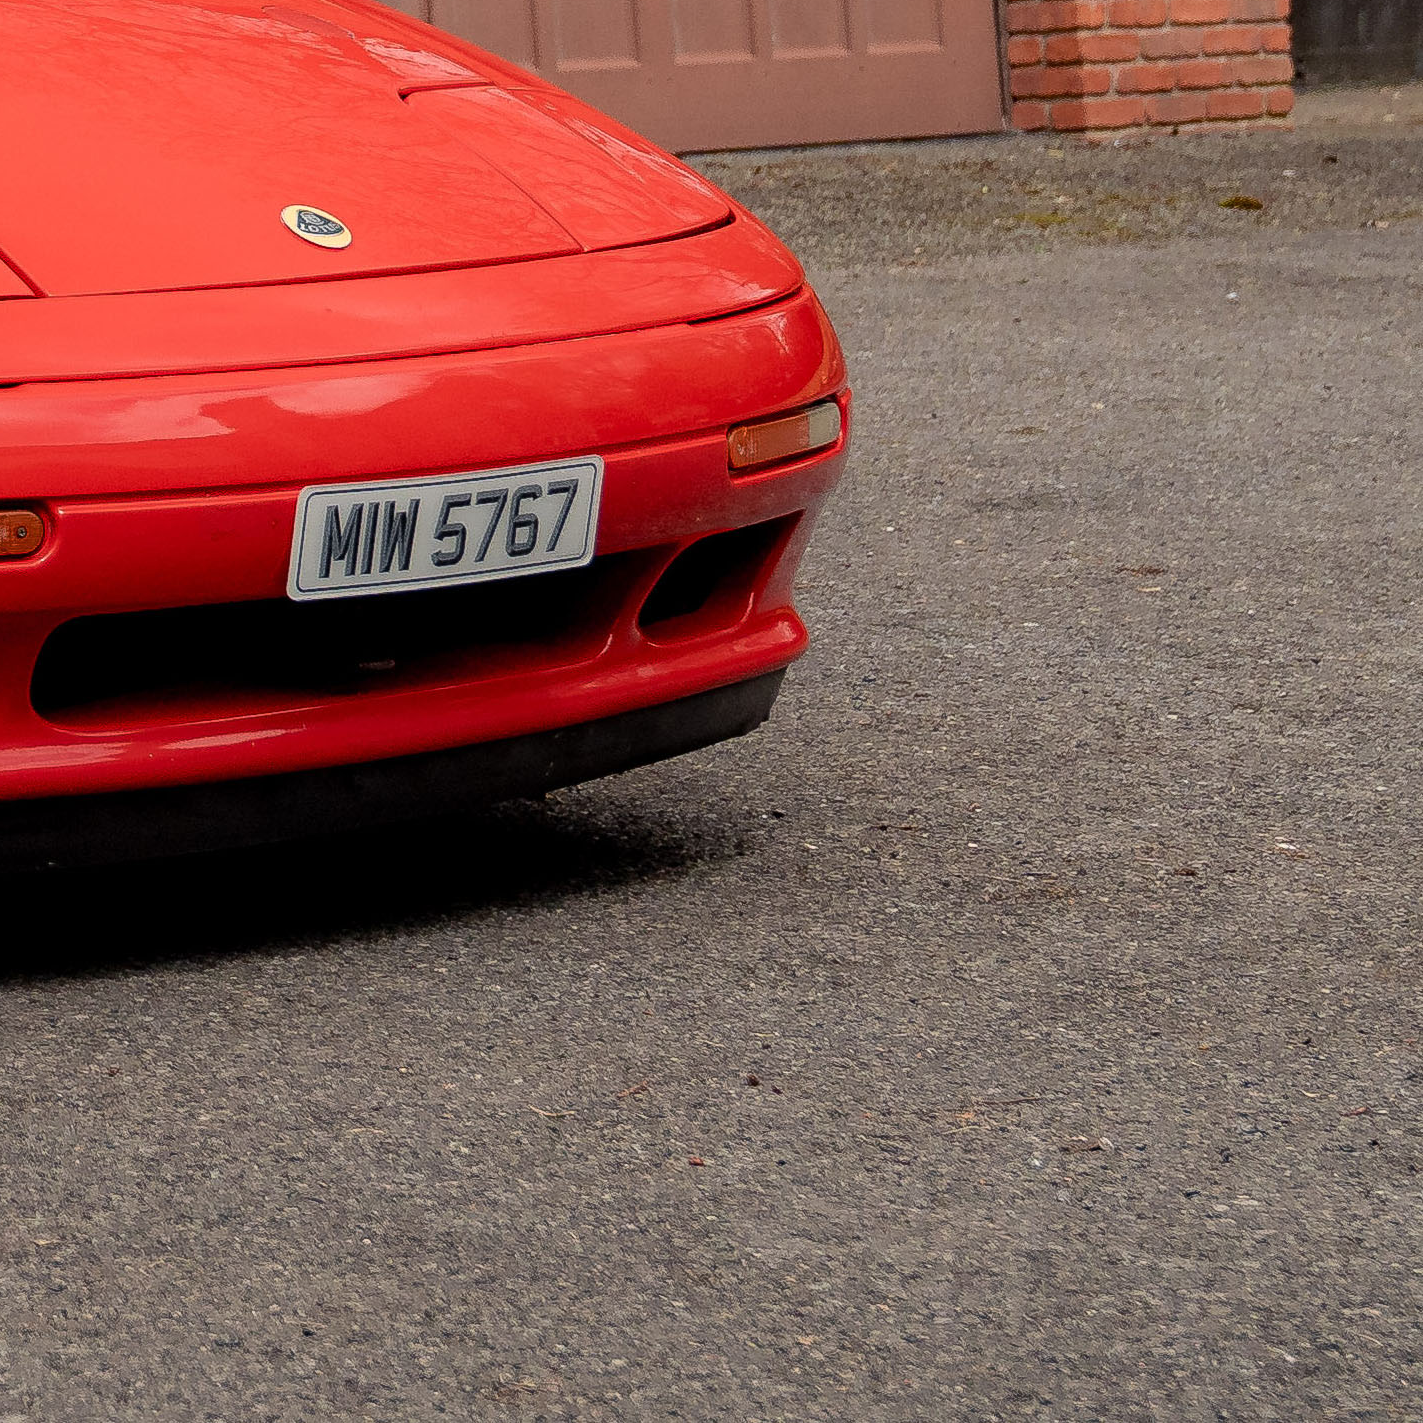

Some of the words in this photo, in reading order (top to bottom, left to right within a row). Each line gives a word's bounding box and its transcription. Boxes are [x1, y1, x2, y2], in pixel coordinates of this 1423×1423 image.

[299, 221, 340, 233] LOTUS
[318, 498, 421, 578] MIW
[430, 478, 580, 567] 5767
